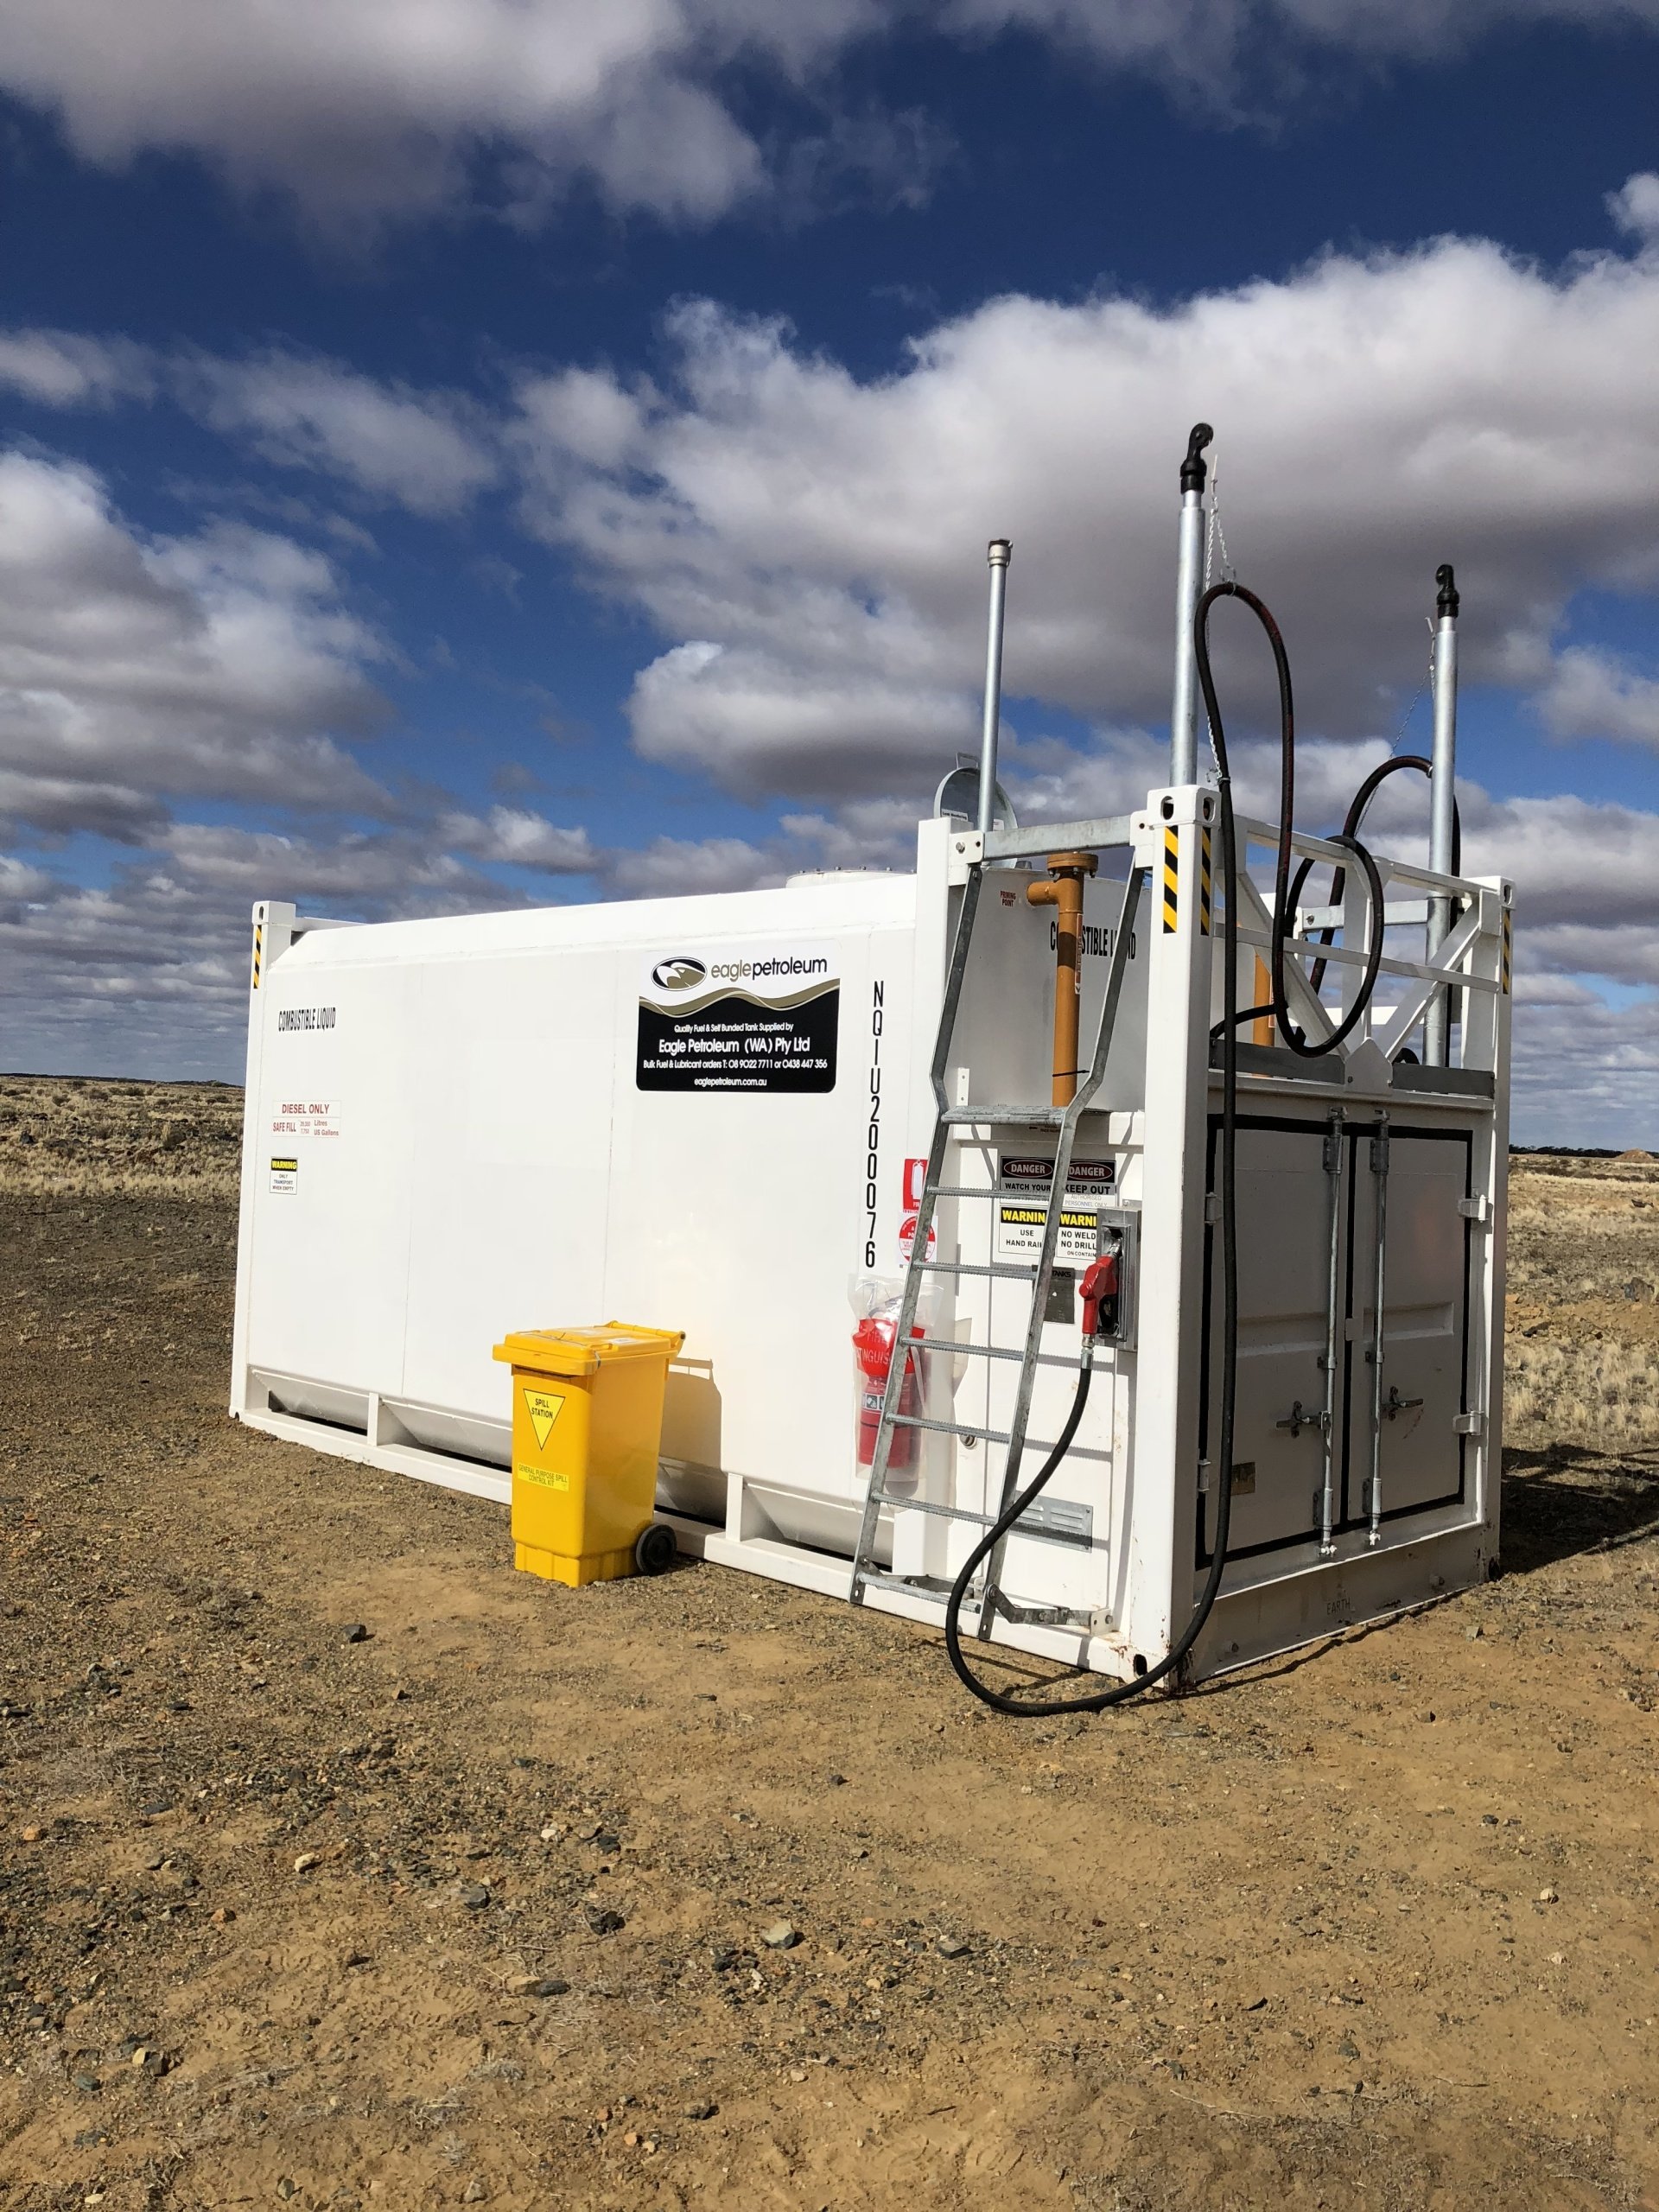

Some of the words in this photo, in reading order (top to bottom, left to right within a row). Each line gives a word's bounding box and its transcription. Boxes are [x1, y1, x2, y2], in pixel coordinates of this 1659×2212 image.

[1001, 898, 1014, 907] POINT
[1050, 921, 1109, 957] CSTIBLE
[710, 957, 828, 982] eaglepetroleum
[278, 1007, 316, 1032] COMBUSTIBLE
[316, 1007, 336, 1033] LIQUID
[674, 1024, 693, 1034] Quality
[694, 1024, 705, 1033] Fuel
[706, 1024, 710, 1033] &
[711, 1024, 721, 1033] Self
[721, 1023, 744, 1032] Bunded
[759, 1022, 785, 1033] Supplied
[785, 1021, 794, 1032] by
[658, 1039, 686, 1057] Eagle
[688, 1039, 740, 1052] Petroleum
[745, 1037, 773, 1054] (WA)
[775, 1037, 791, 1055] Pty
[794, 1037, 810, 1052] Ltd
[643, 1059, 656, 1069] Bulk
[656, 1059, 668, 1068] Fuel
[669, 1059, 674, 1068] &
[674, 1059, 702, 1069] Lubricant
[702, 1059, 722, 1069] orders
[722, 1059, 728, 1069] T:
[728, 1059, 738, 1069] 08
[739, 1059, 757, 1069] 9022
[758, 1059, 773, 1069] 7711
[774, 1060, 782, 1069] or
[782, 1059, 800, 1069] 0438
[800, 1059, 814, 1069] 447
[814, 1058, 828, 1069] 356
[694, 1077, 767, 1088] eaglepetroleum.com.au
[282, 1104, 307, 1114] DIESEL
[308, 1103, 330, 1115] ONLY
[272, 1122, 285, 1132] SAFE
[286, 1122, 296, 1132] FILL
[271, 1160, 297, 1170] WARNING
[1010, 1163, 1046, 1174] DANGER
[1068, 1166, 1105, 1177] DANGER
[1090, 1185, 1110, 1194] OUT
[1002, 1210, 1046, 1223] WARNIN
[1060, 1213, 1096, 1227] WARNI
[1074, 1231, 1096, 1240] WELD
[1074, 1241, 1096, 1250] DRILL
[535, 1398, 550, 1408] SPILL
[531, 1407, 554, 1419] STATION
[556, 1473, 568, 1483] SPILL
[1326, 1597, 1351, 1615] EARTH
